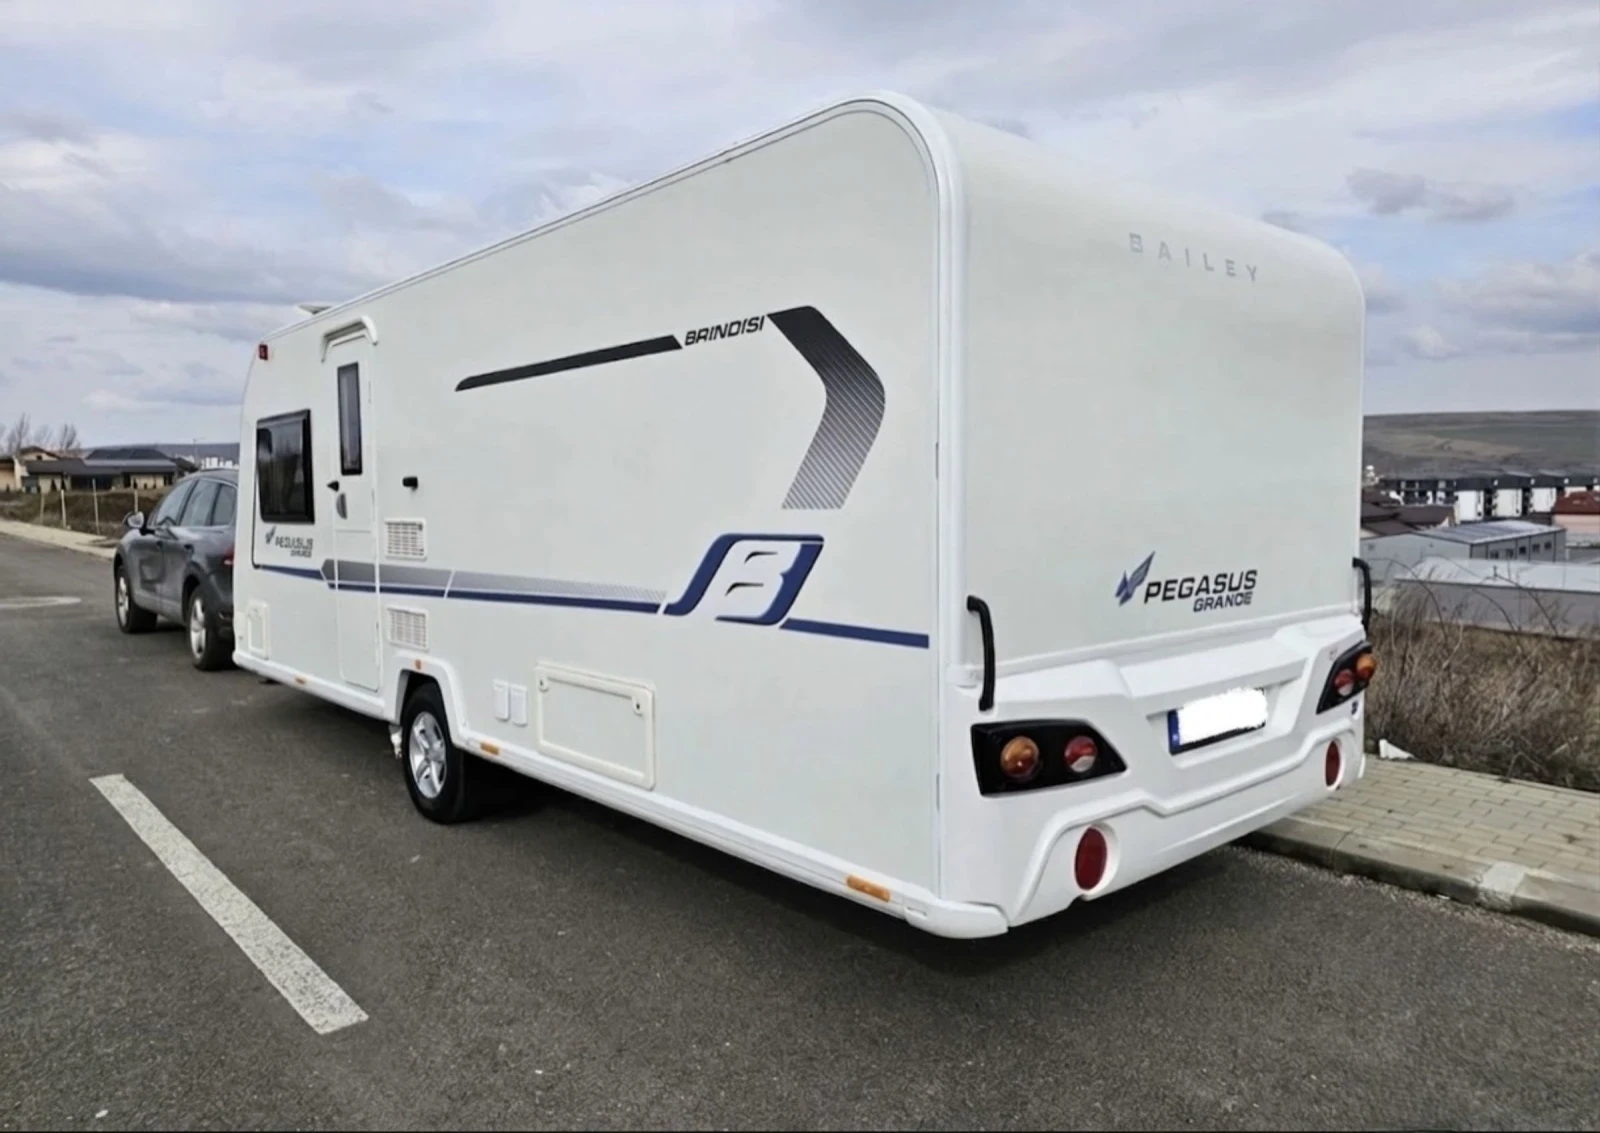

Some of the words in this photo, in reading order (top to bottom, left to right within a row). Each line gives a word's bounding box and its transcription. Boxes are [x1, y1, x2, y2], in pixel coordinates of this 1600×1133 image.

[1129, 232, 1257, 282] BAILEY
[684, 315, 765, 346] BRINDISI
[1144, 569, 1257, 604] PEGASUS
[1193, 591, 1253, 612] GRANDE
